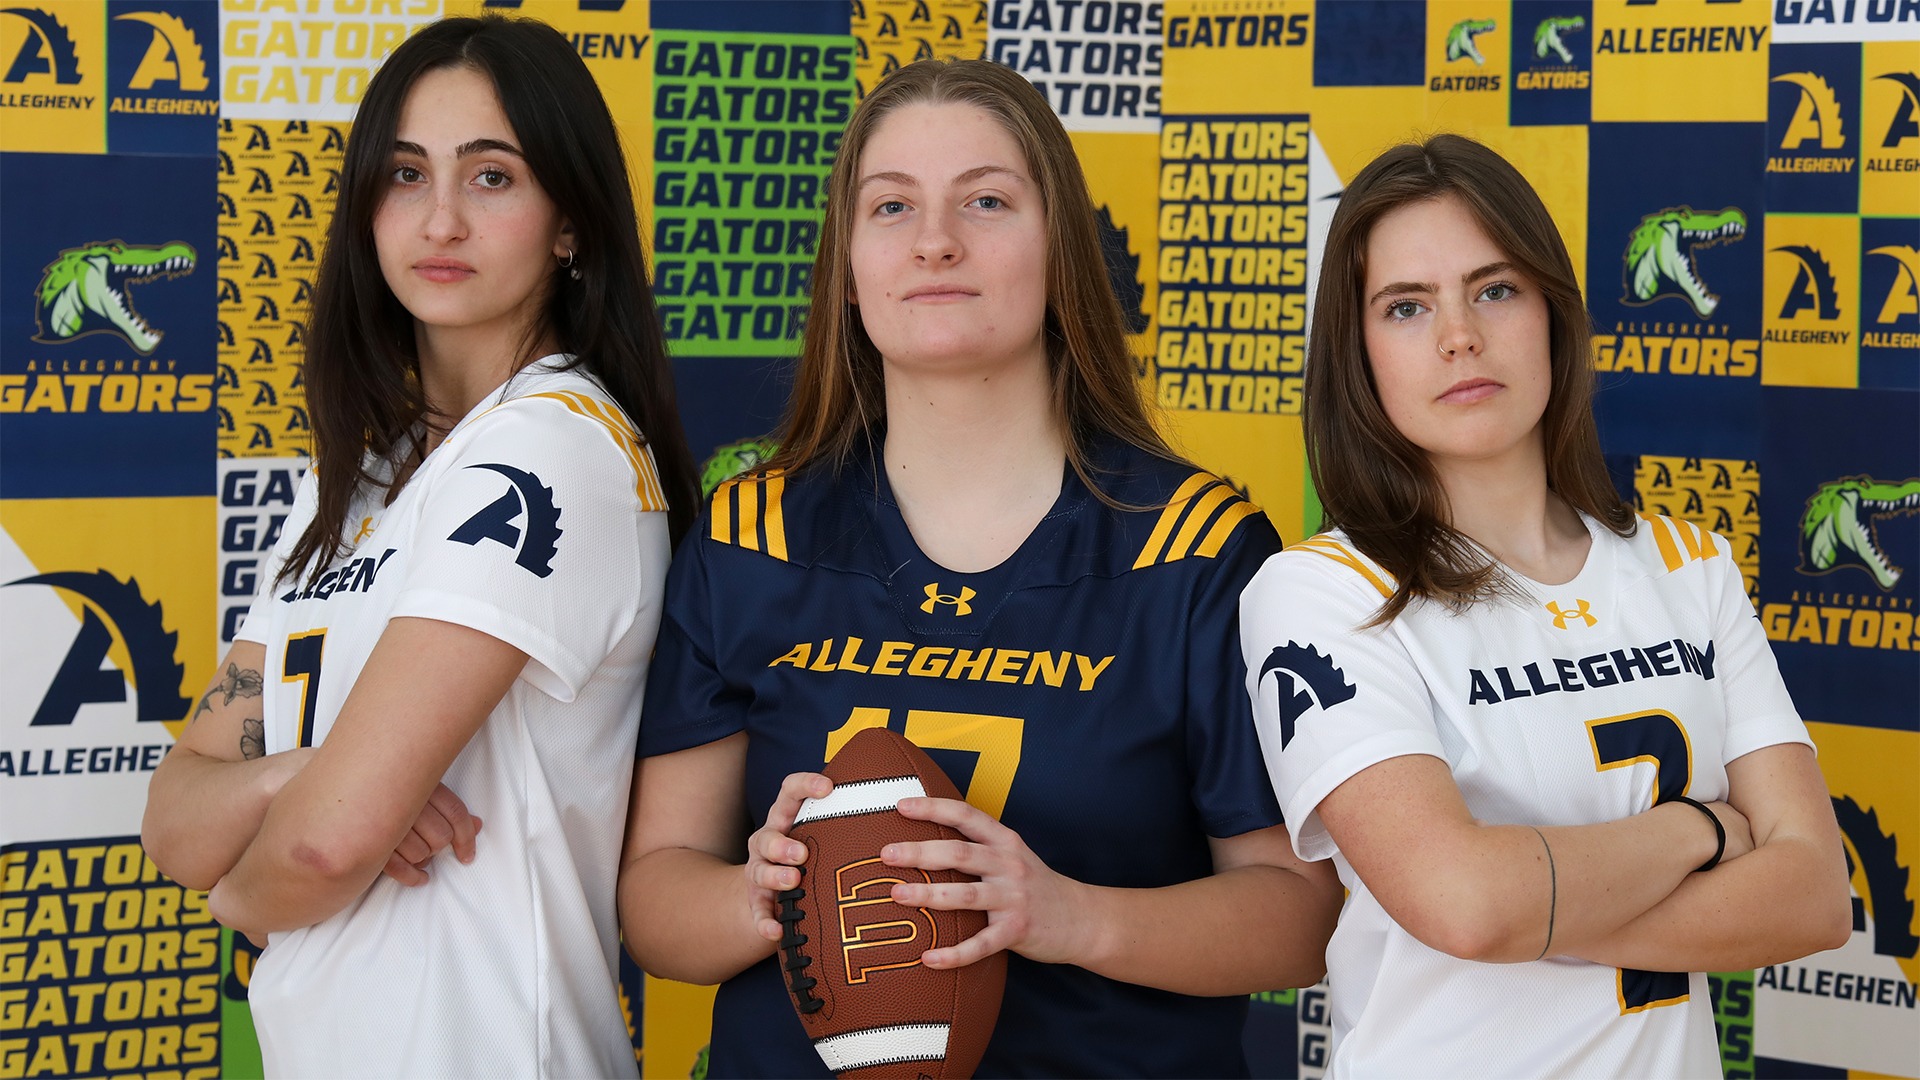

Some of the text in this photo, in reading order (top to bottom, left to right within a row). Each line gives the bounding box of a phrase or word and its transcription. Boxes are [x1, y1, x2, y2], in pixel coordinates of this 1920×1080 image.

[992, 0, 1163, 35] GATORS
[1168, 14, 1310, 48] GATORS
[223, 20, 425, 59] GATOR
[1597, 26, 1768, 54] ALLEGHENY
[655, 41, 853, 81] GATORS
[223, 66, 382, 104] GATO
[1032, 82, 1161, 117] TORS
[1430, 76, 1501, 92] GATORS
[1516, 71, 1590, 90] GATORS
[110, 97, 219, 115] ALLEGHENY
[654, 84, 851, 123] GATORS
[1161, 121, 1309, 160] GATORS
[1160, 163, 1308, 201] GATORS
[1765, 157, 1855, 172] ALLEGHENY
[1159, 204, 1308, 243] GATORS
[1158, 246, 1307, 286] GATORS
[1158, 290, 1306, 331] GATORS
[1616, 321, 1730, 336] ALLEGHENY
[1157, 331, 1305, 372] GATORS
[1592, 335, 1760, 377] GATORS
[1763, 329, 1850, 345] ALLEGHENY
[27, 360, 177, 372] ALLEGHENY
[0, 375, 216, 412] GATORS
[1158, 372, 1303, 414] GATORS
[1791, 590, 1912, 609] ALLEGHENY
[768, 636, 1116, 692] ALLEGHENY
[1468, 638, 1716, 705] ALLEGHENY
[0, 745, 174, 776] ALLEGHE
[0, 927, 220, 984] GATORS
[0, 973, 220, 1031] GATORS
[0, 1022, 220, 1079] GATORS
